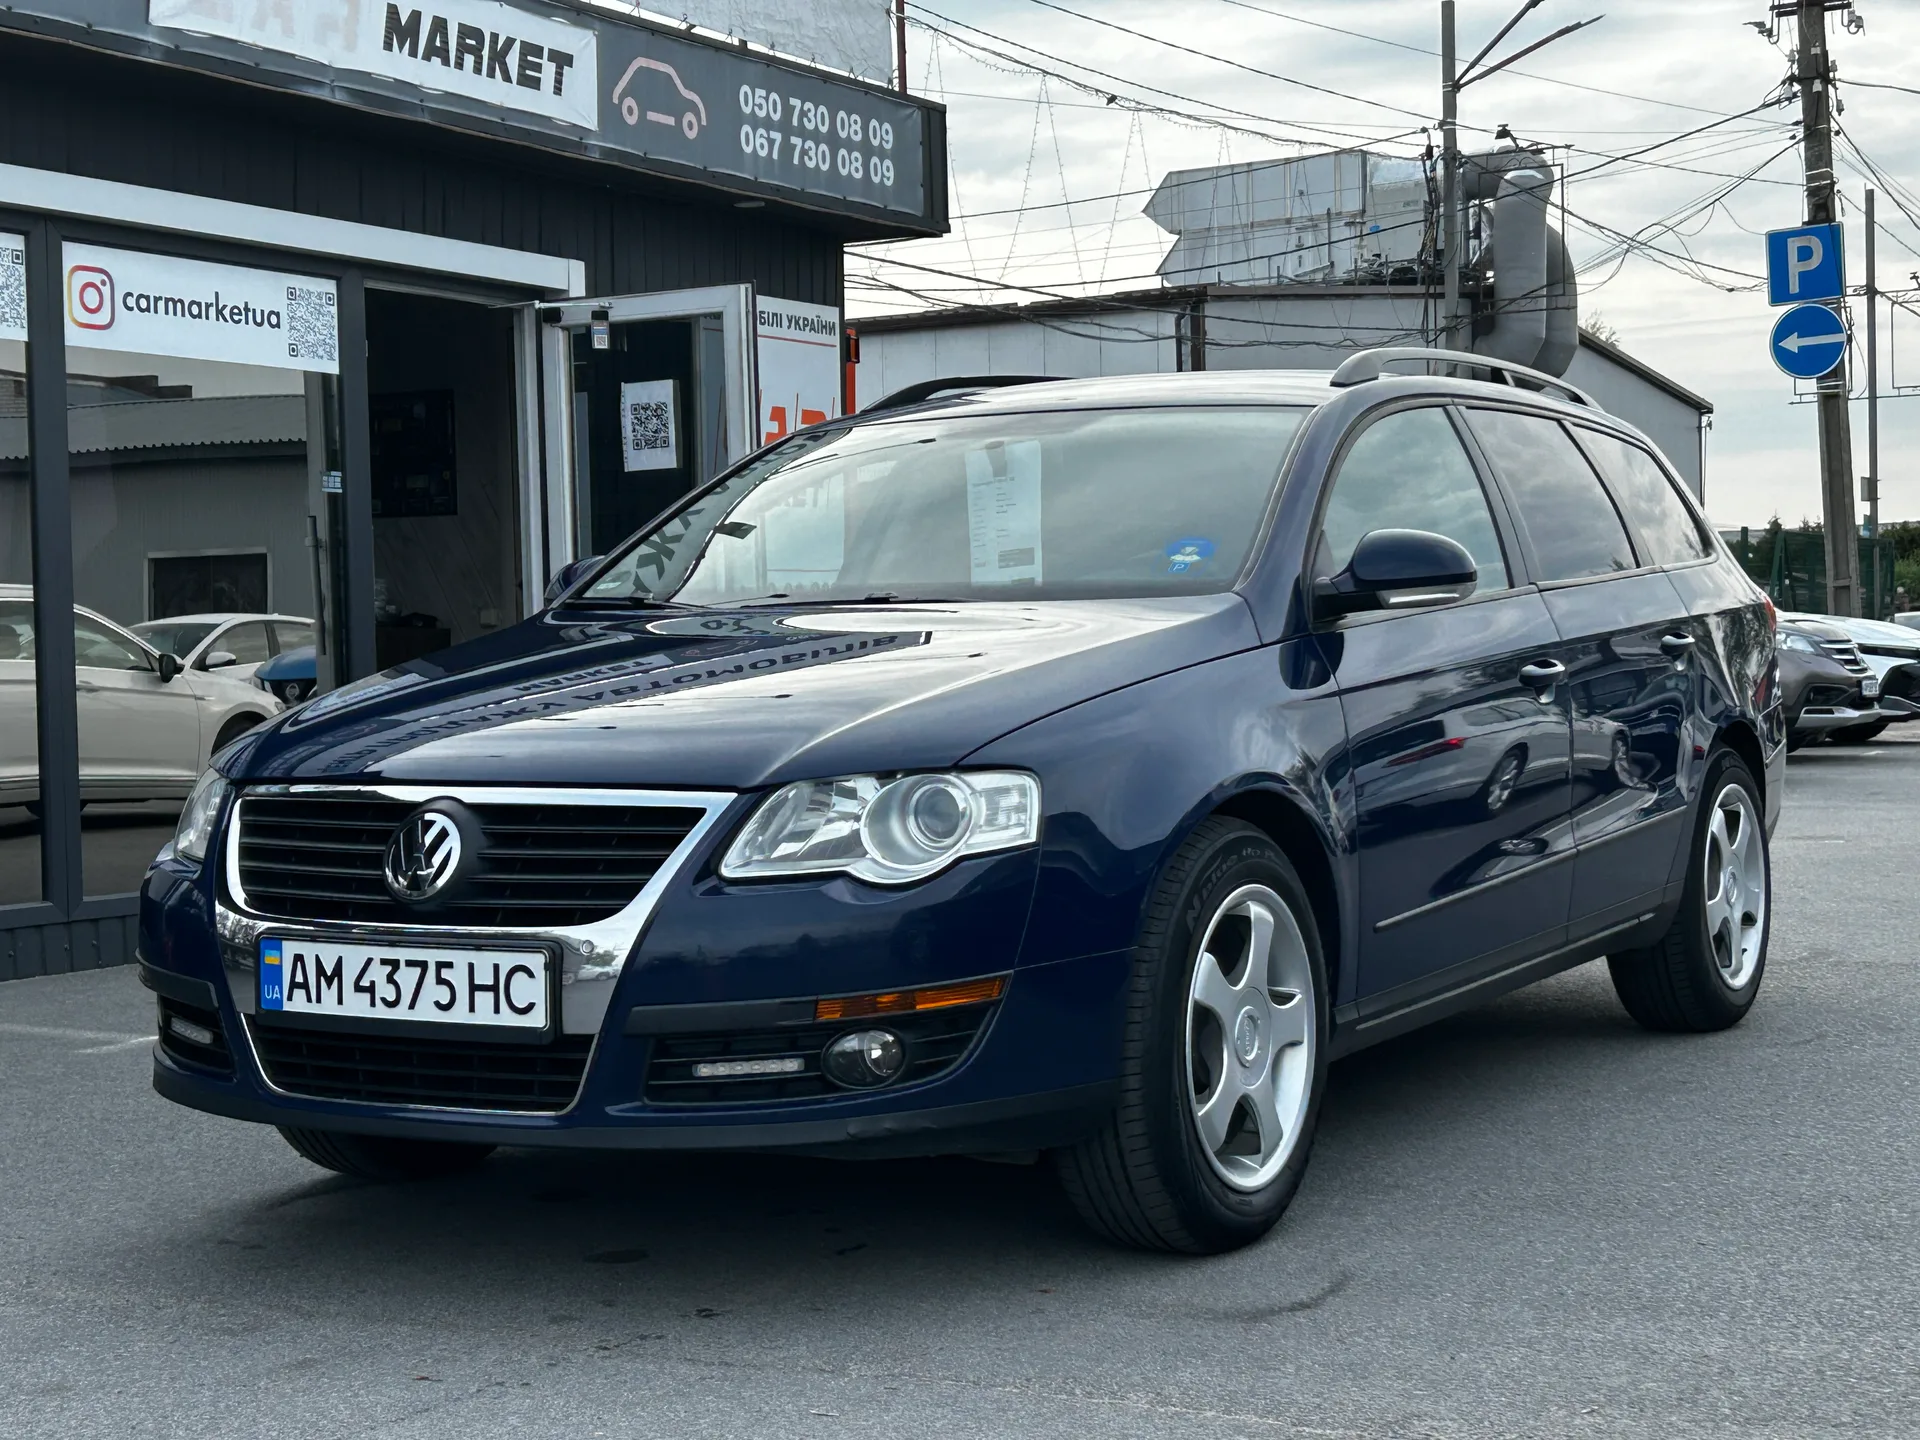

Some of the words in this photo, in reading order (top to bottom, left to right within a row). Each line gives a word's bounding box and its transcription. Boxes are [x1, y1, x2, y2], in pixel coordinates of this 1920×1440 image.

[383, 2, 574, 96] MARKET
[739, 84, 782, 121] 050
[789, 97, 829, 133] 730
[836, 110, 862, 141] 08
[868, 118, 893, 150] 09
[740, 124, 782, 160] 067
[790, 136, 830, 171] 730
[837, 148, 863, 179] 08
[869, 156, 894, 186] 09
[1787, 235, 1823, 295] P
[122, 291, 281, 329] carmarketua
[786, 314, 836, 336] УКРАЇНИ
[264, 985, 281, 999] UA
[287, 953, 343, 1005] AM
[354, 957, 456, 1011] 4375
[468, 962, 536, 1015] HC
